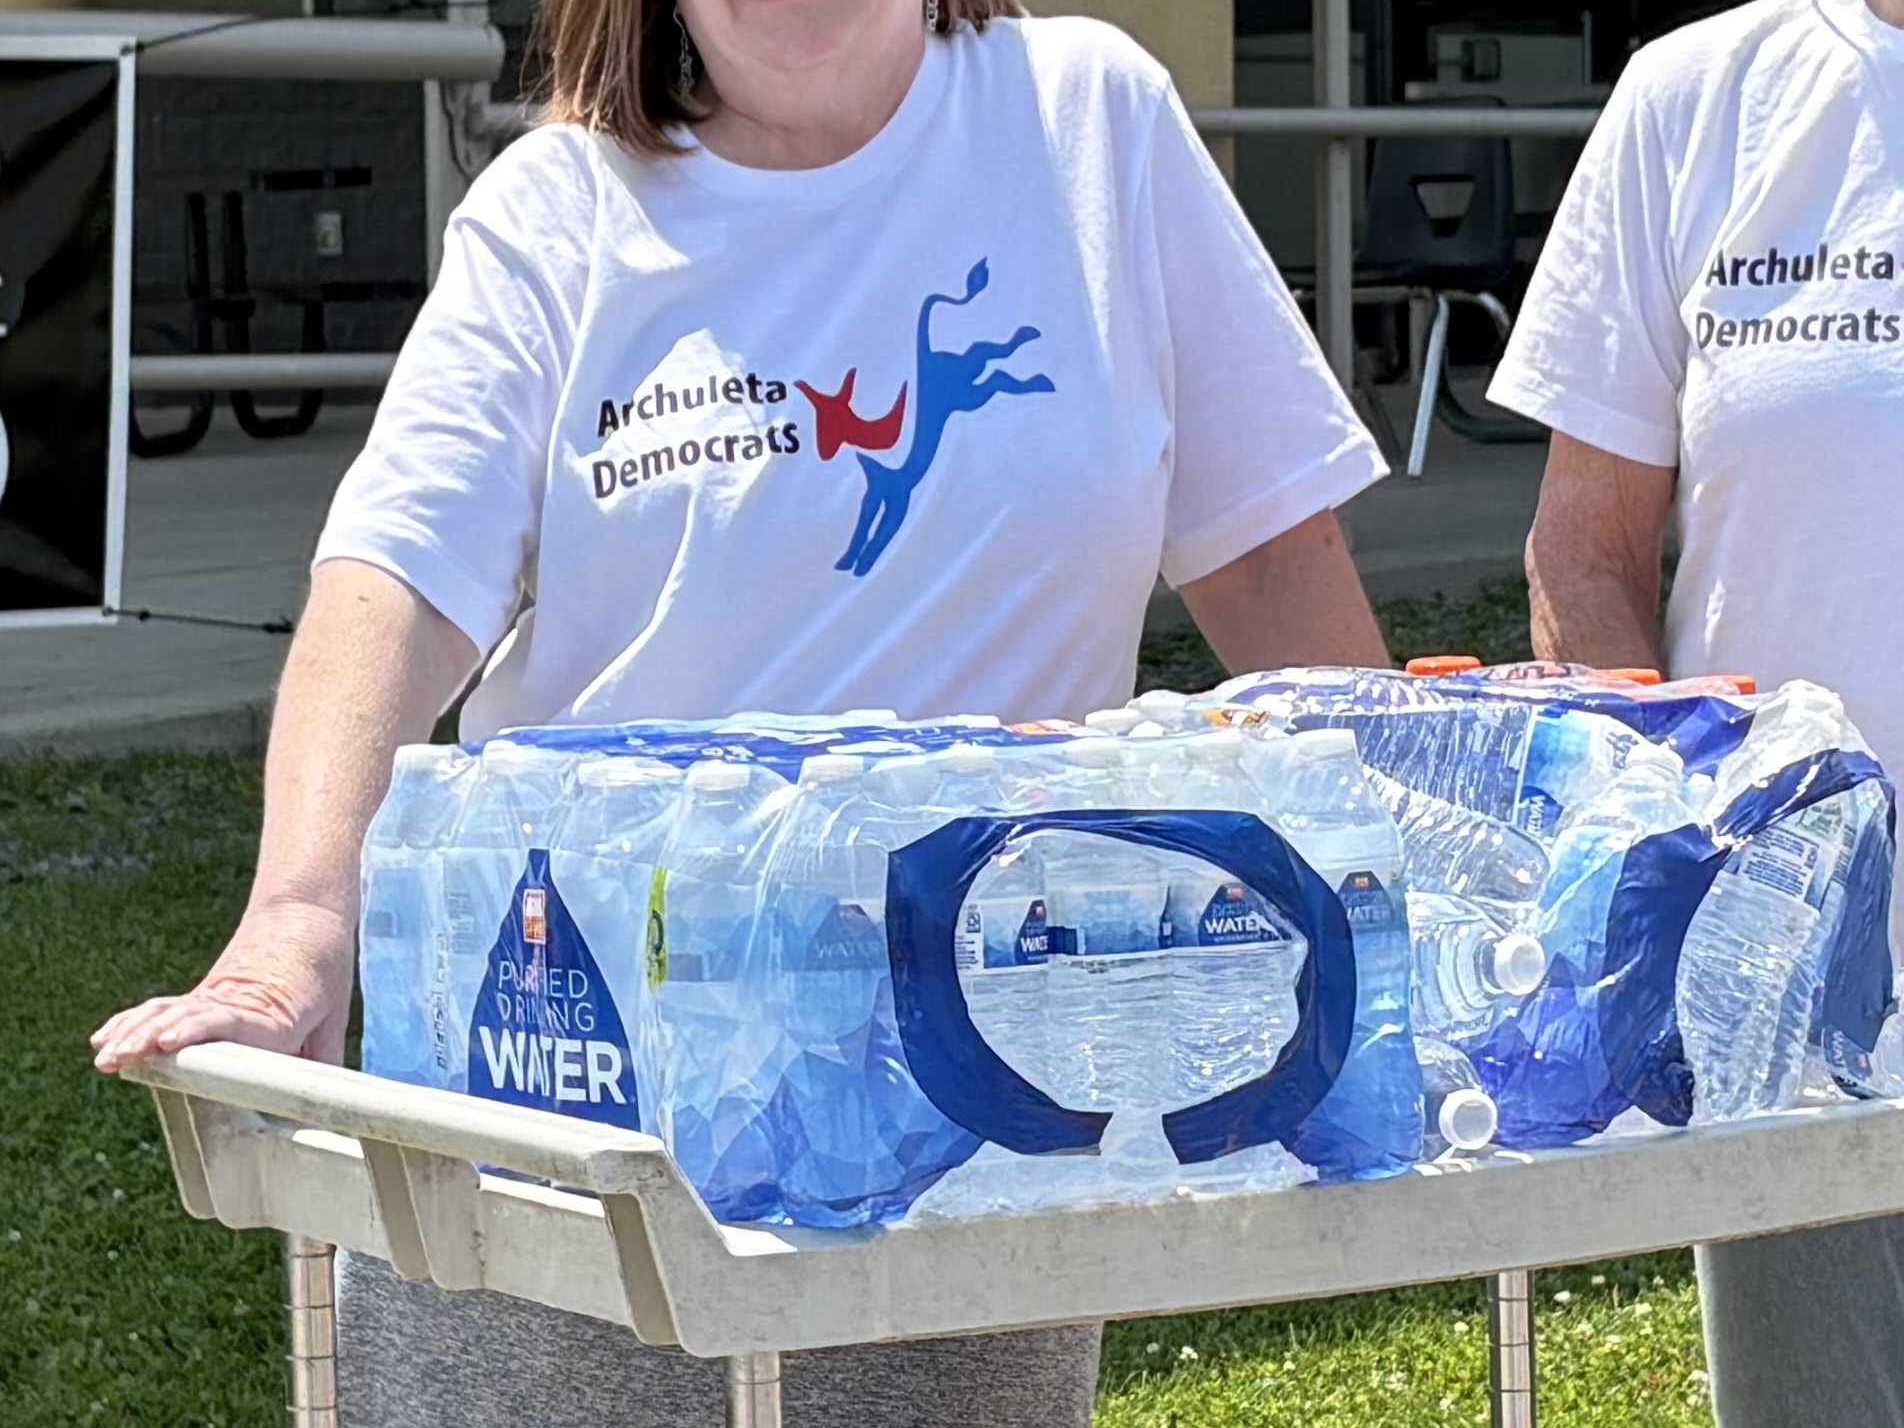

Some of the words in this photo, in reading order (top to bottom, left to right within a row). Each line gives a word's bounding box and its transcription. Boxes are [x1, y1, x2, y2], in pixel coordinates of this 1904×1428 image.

[1704, 243, 1895, 288] Archuleta
[1696, 307, 1901, 351] Democrats
[596, 371, 789, 439] Archuleta
[591, 421, 801, 500] Democrats
[477, 1024, 628, 1105] WATER
